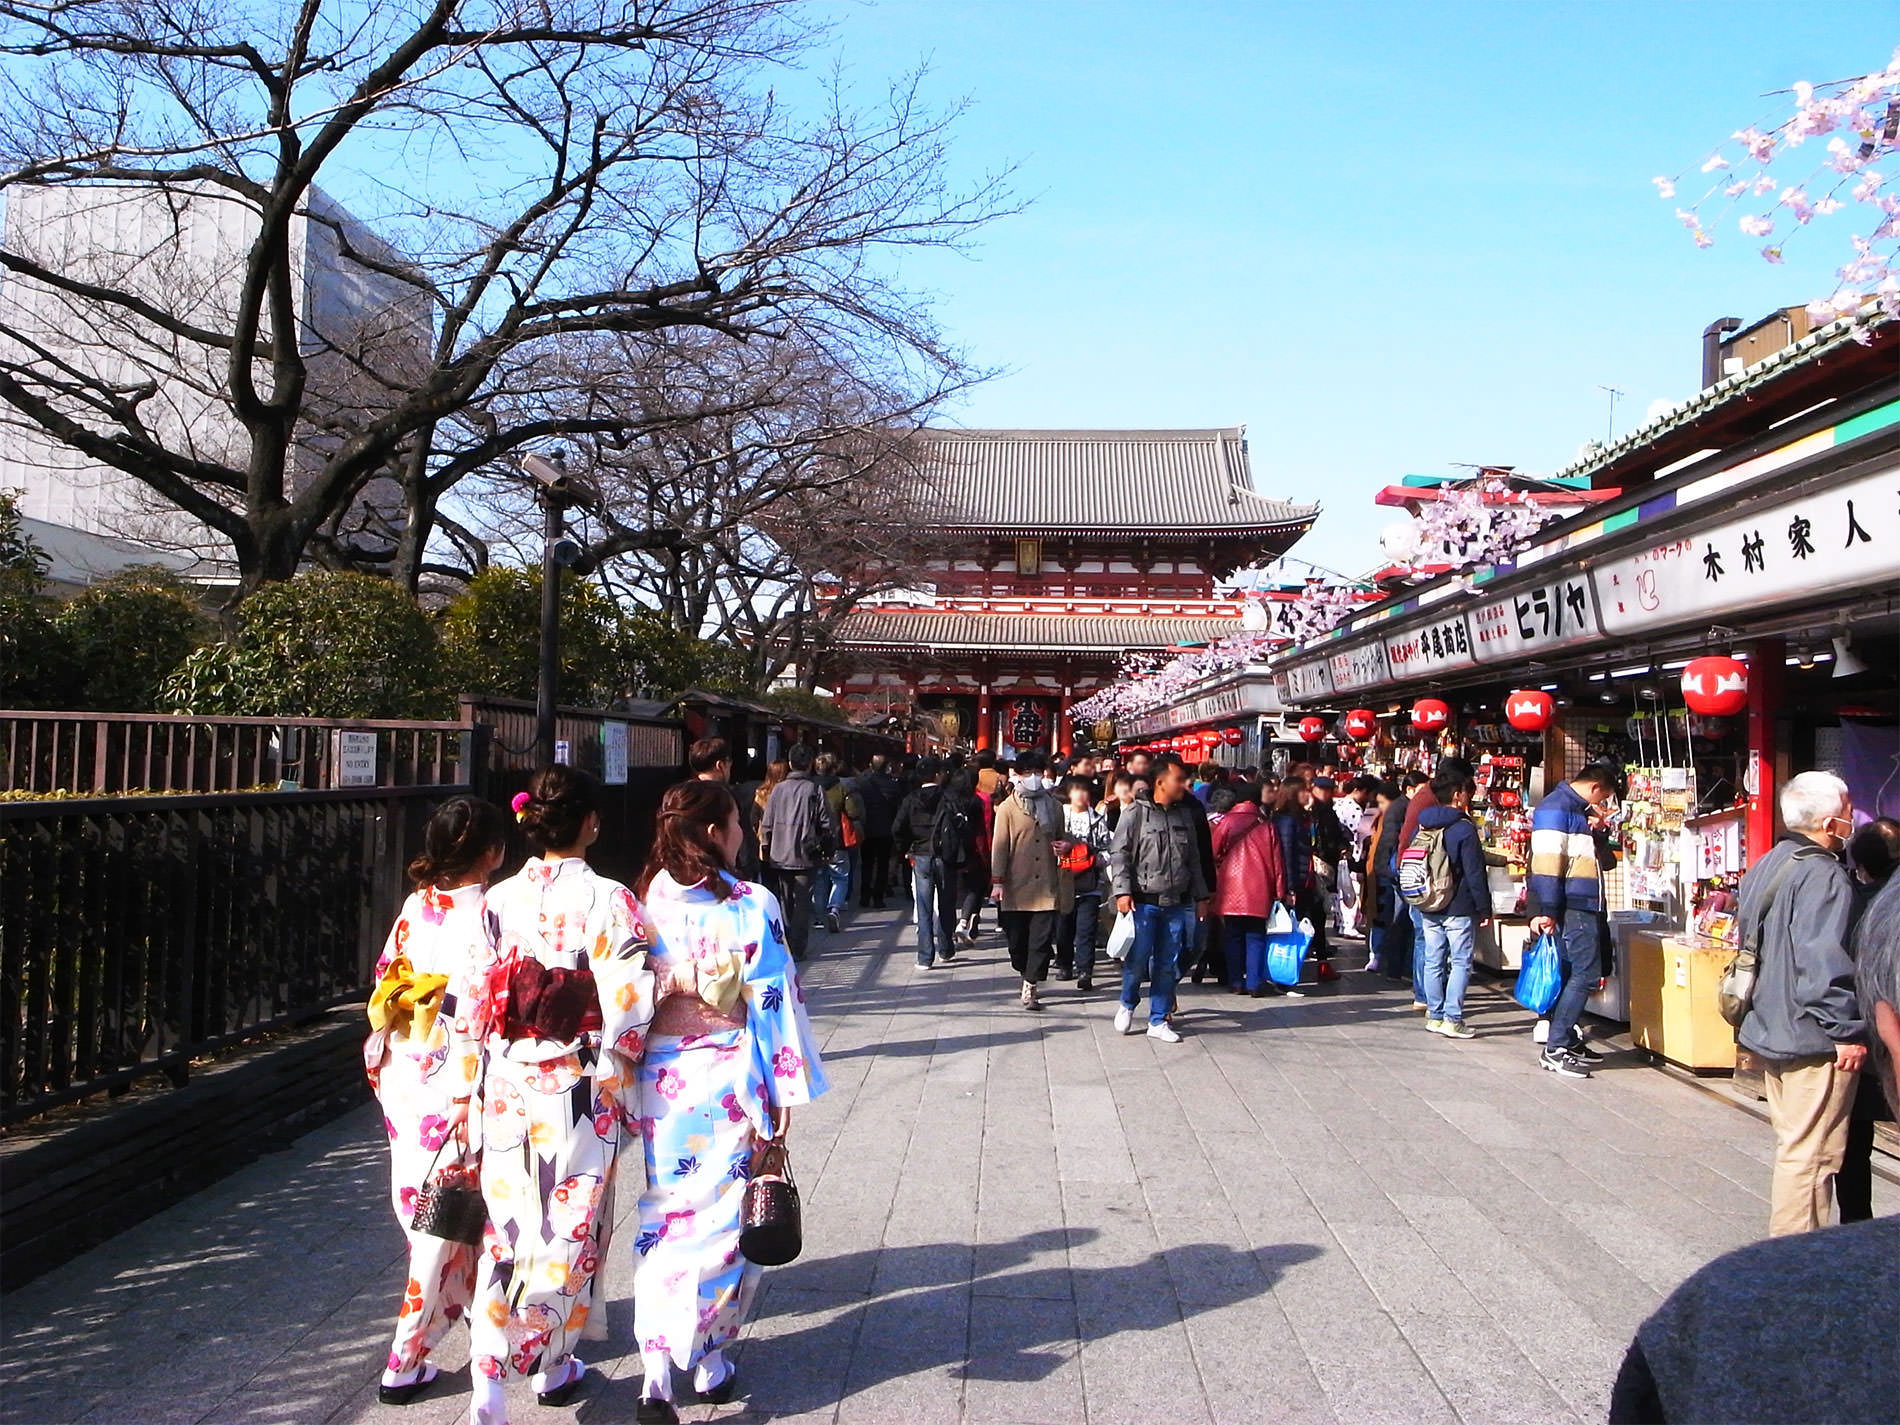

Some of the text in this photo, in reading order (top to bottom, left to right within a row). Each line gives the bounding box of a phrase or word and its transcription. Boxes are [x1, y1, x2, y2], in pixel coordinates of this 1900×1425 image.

[1703, 499, 1900, 582] 木村家人
[1513, 581, 1586, 640] ヒラノヤ
[1420, 619, 1468, 664] 平尾商店
